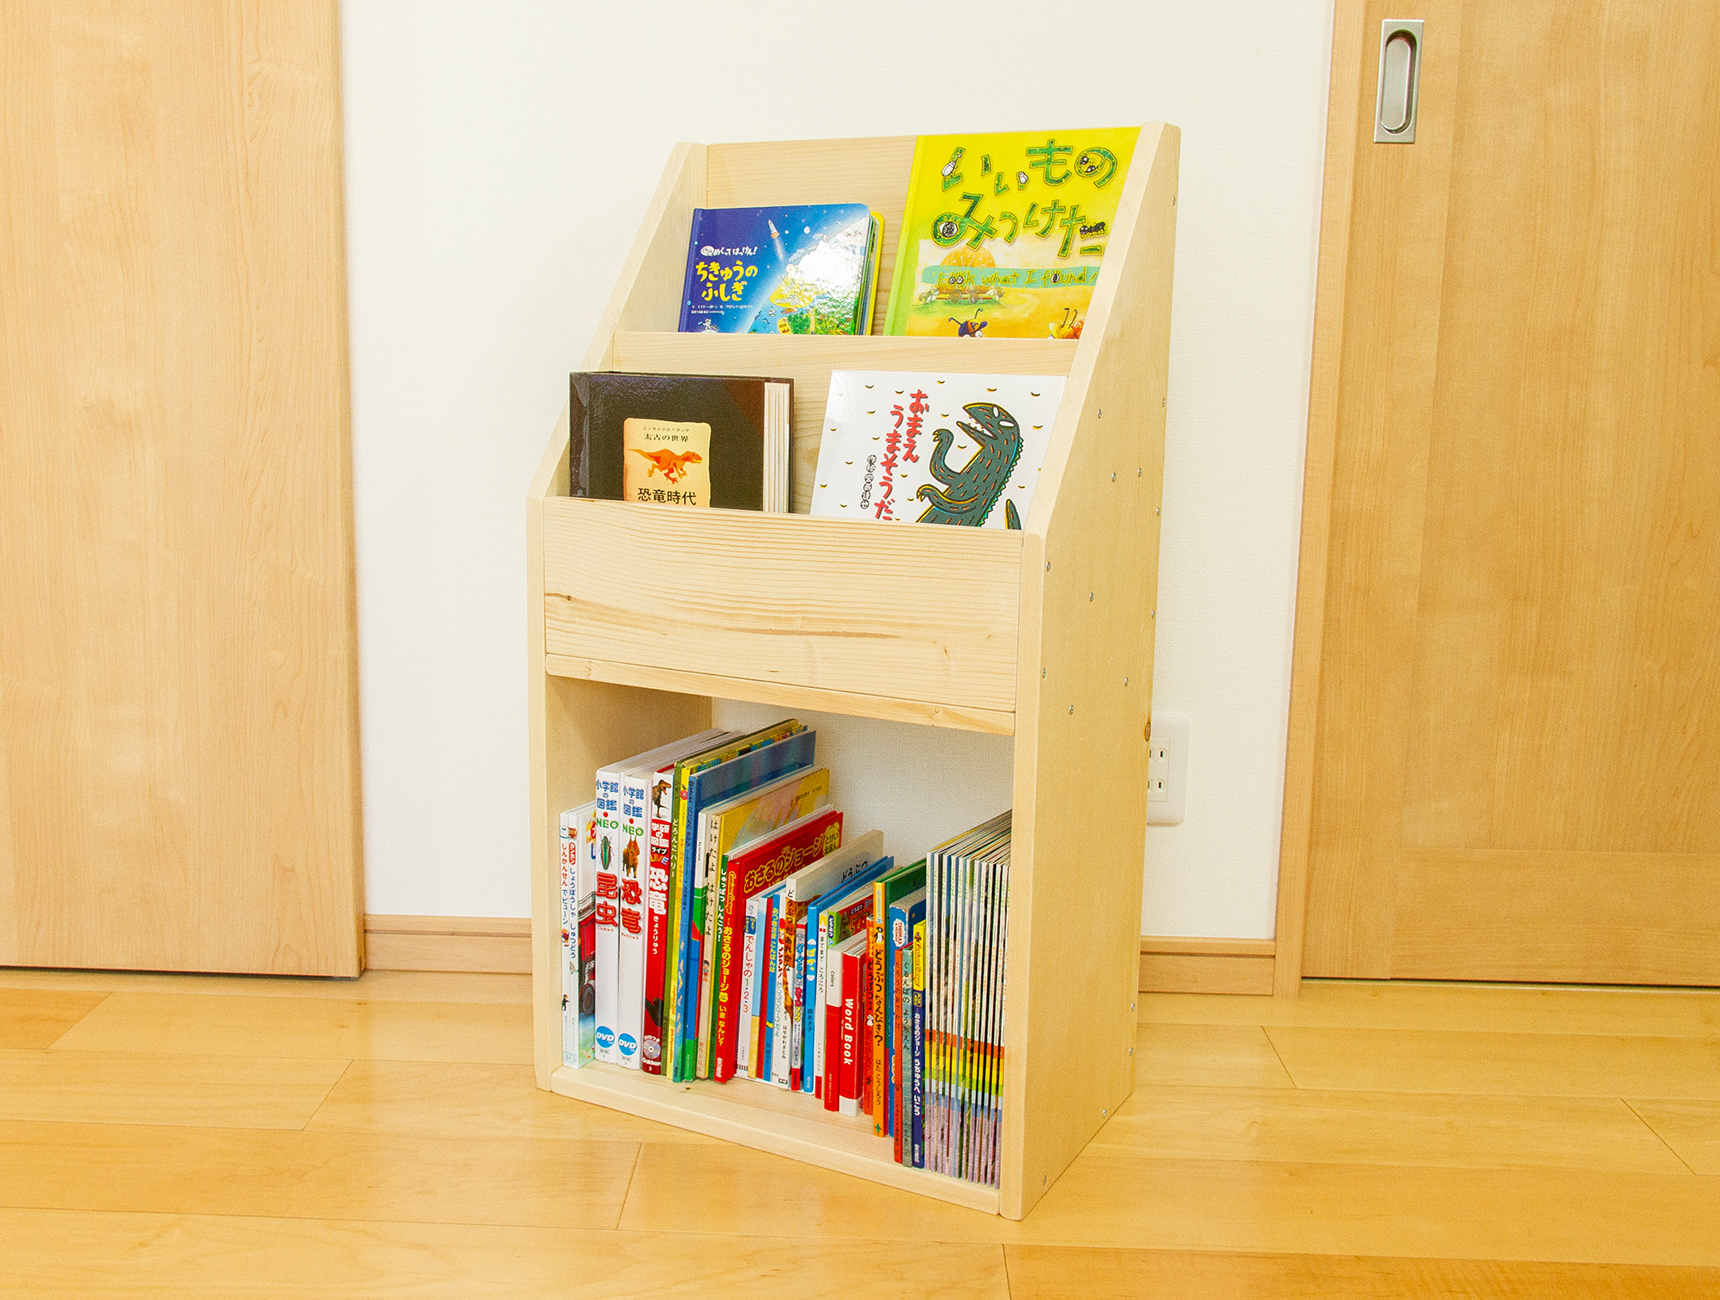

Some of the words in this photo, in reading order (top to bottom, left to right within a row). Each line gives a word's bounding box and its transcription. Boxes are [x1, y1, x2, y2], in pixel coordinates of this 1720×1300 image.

[941, 138, 1118, 197] いいもの
[930, 192, 1107, 259] みつけた
[695, 260, 758, 282] ちきゅうの
[937, 270, 975, 287] Look
[981, 271, 1020, 285] what
[1025, 270, 1038, 284] I
[701, 280, 748, 301] ふしぎ
[645, 433, 689, 442] 太古の世界
[901, 389, 930, 463] おまえ
[874, 404, 905, 521] うまそうだ
[637, 487, 697, 505] 恐竜時代
[596, 779, 619, 793] 小学館
[623, 785, 645, 800] 小学館
[596, 797, 618, 811] 図鑑
[623, 803, 643, 818] 図鑑
[595, 817, 619, 830] NEO
[622, 823, 644, 837] NEO
[651, 822, 670, 833] 学研
[670, 818, 679, 877] どろんこハリー
[708, 819, 719, 872] はけたよ
[650, 854, 669, 865] LIVE
[744, 833, 824, 894] おさるのジョージ
[595, 871, 618, 928] 昆虫
[649, 866, 669, 915] 恐竜
[621, 878, 642, 934] 恐竜
[704, 882, 715, 936] はけたよ
[720, 926, 733, 991] おさるのジョージ
[902, 961, 910, 1004] ぐるんぱの
[718, 1005, 727, 1019] いま
[843, 998, 854, 1031] Word
[596, 1031, 614, 1042] DVD
[902, 1009, 910, 1051] ようちえん
[619, 1039, 637, 1049] DVD
[843, 1034, 854, 1066] Book
